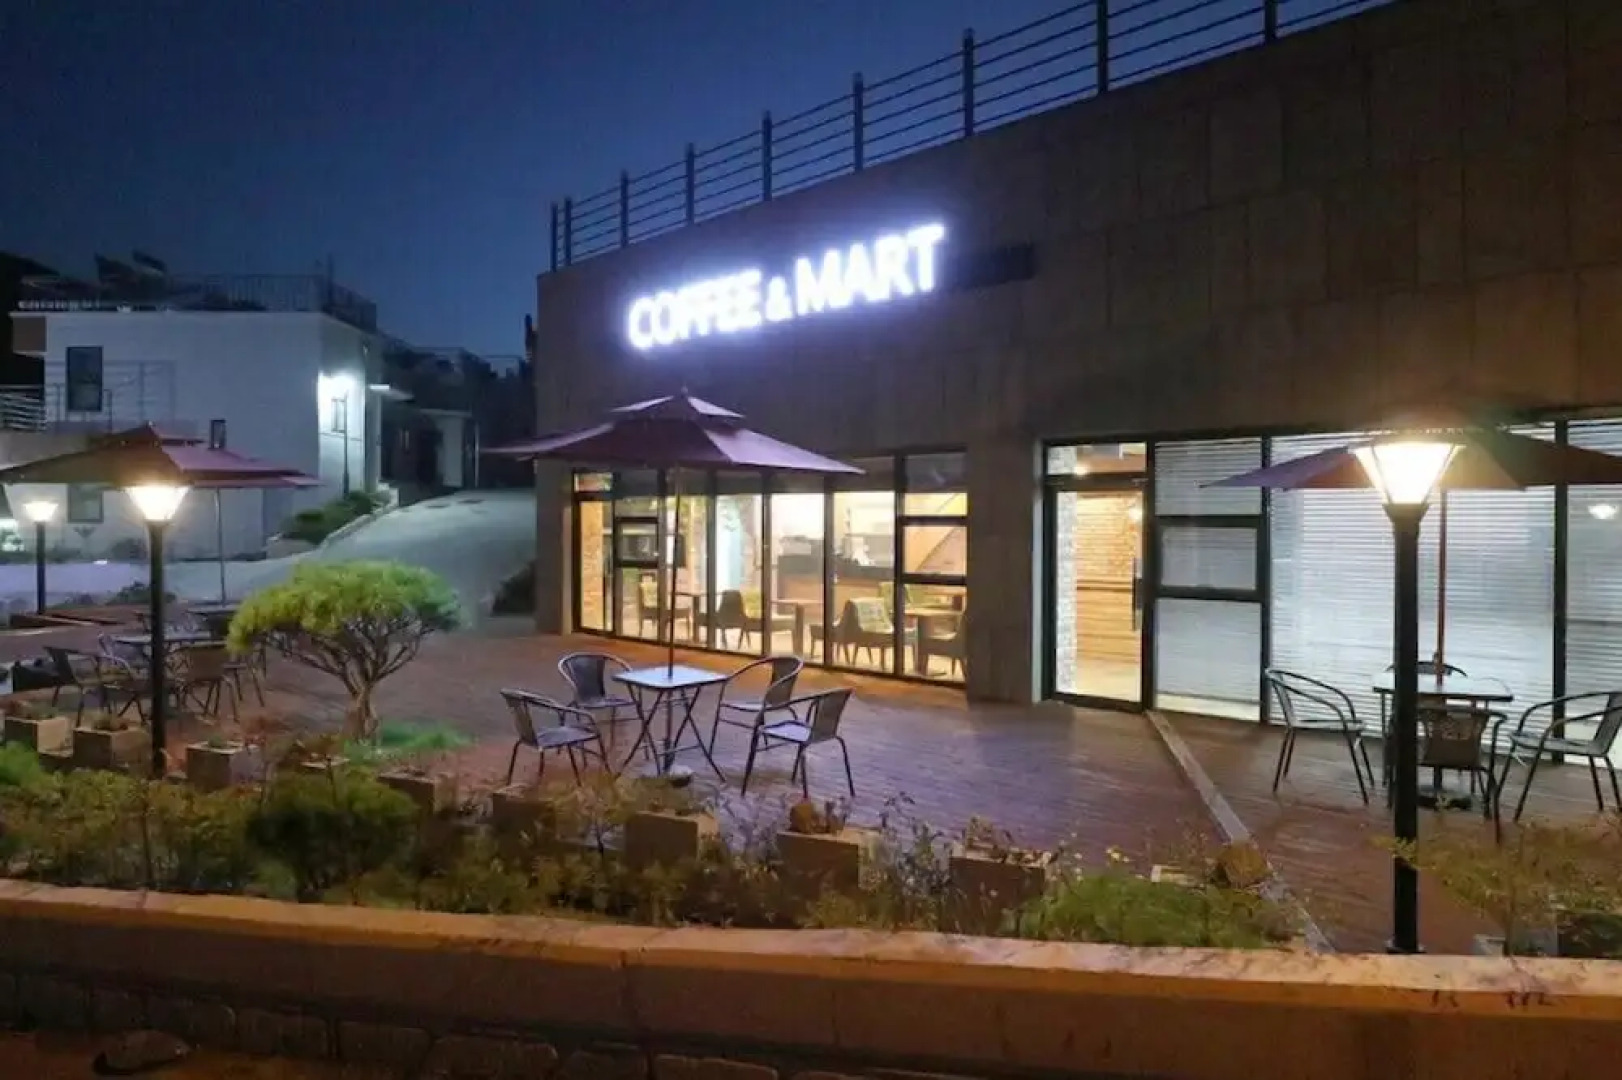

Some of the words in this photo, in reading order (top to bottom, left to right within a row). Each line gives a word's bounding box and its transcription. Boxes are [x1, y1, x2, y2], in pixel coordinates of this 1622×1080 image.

[628, 269, 762, 349] COFFEE
[765, 276, 793, 321] &
[795, 224, 945, 316] MART
